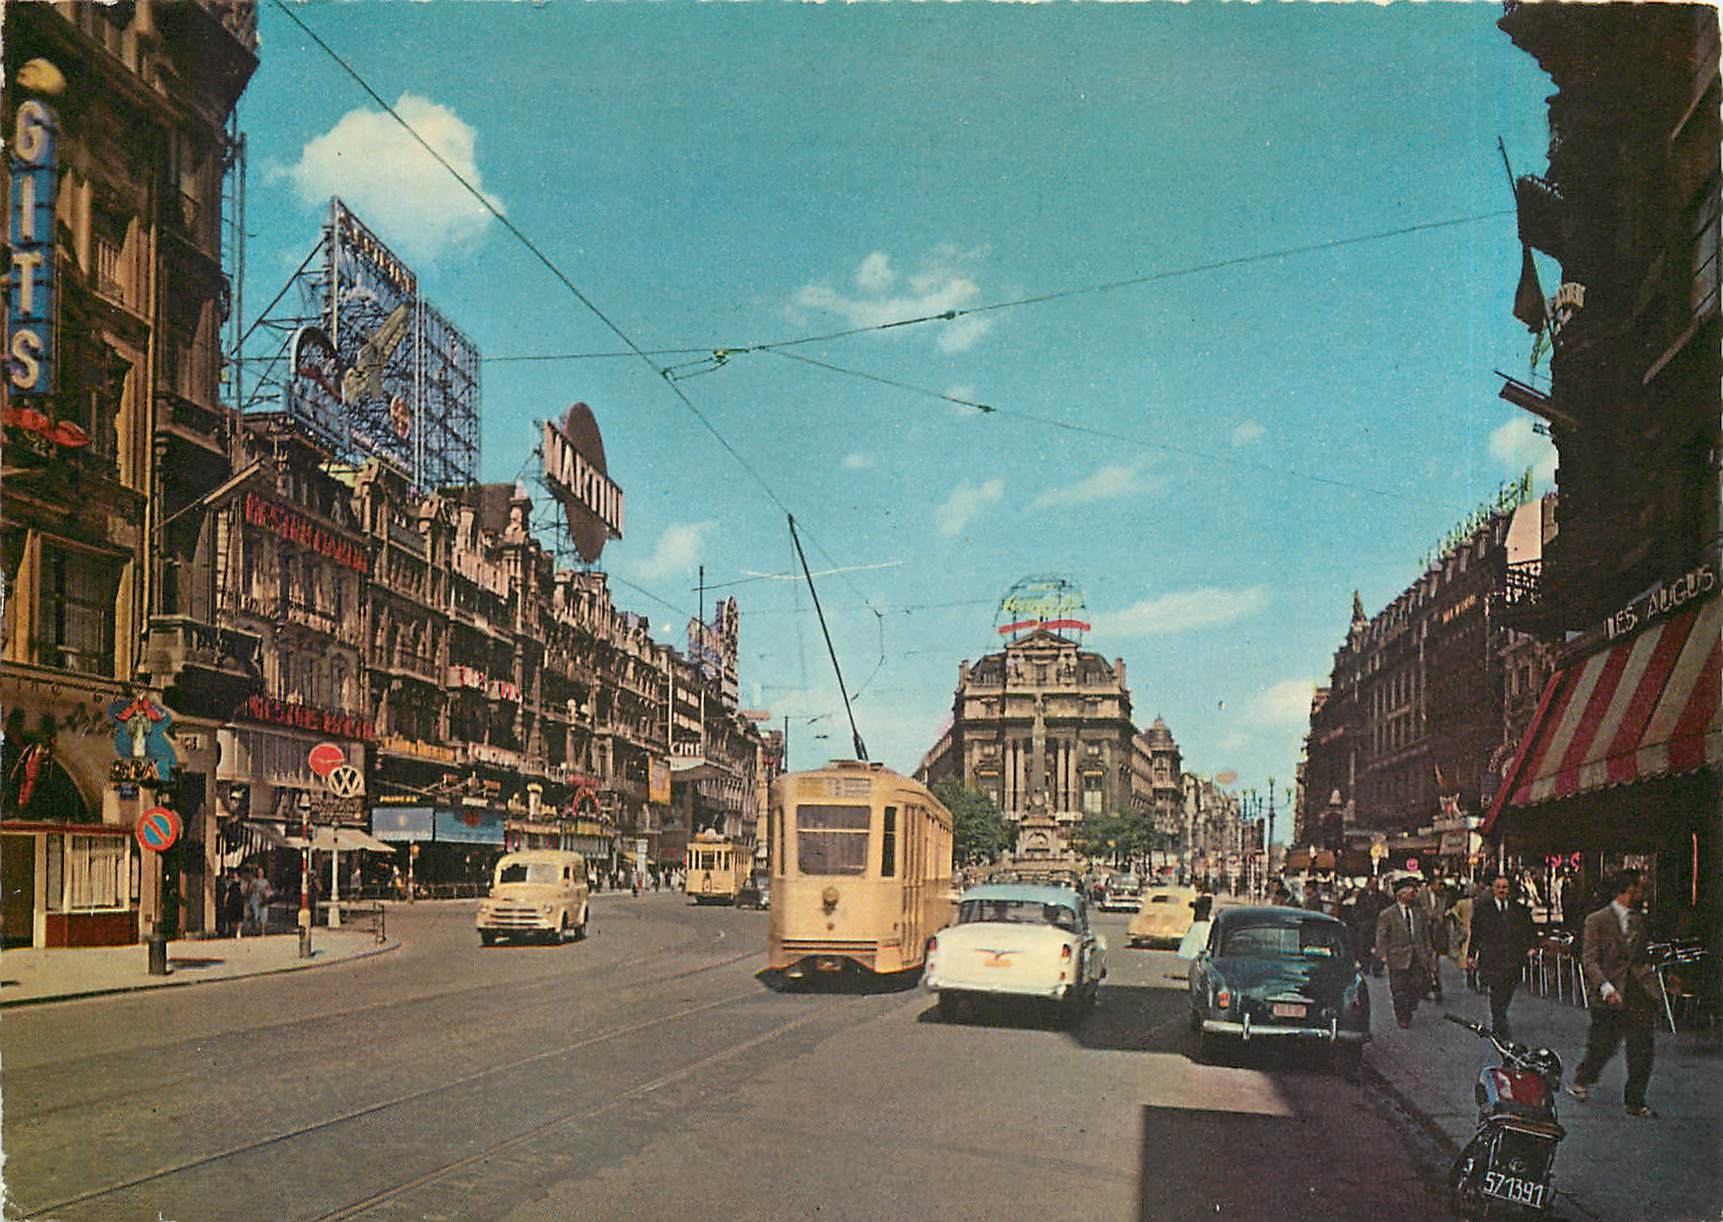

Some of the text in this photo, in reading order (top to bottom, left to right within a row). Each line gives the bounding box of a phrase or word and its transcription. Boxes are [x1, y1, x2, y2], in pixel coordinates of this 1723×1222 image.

[544, 421, 625, 536] MARTINI
[1647, 564, 1715, 621] AUGUS
[328, 765, 363, 798] VW
